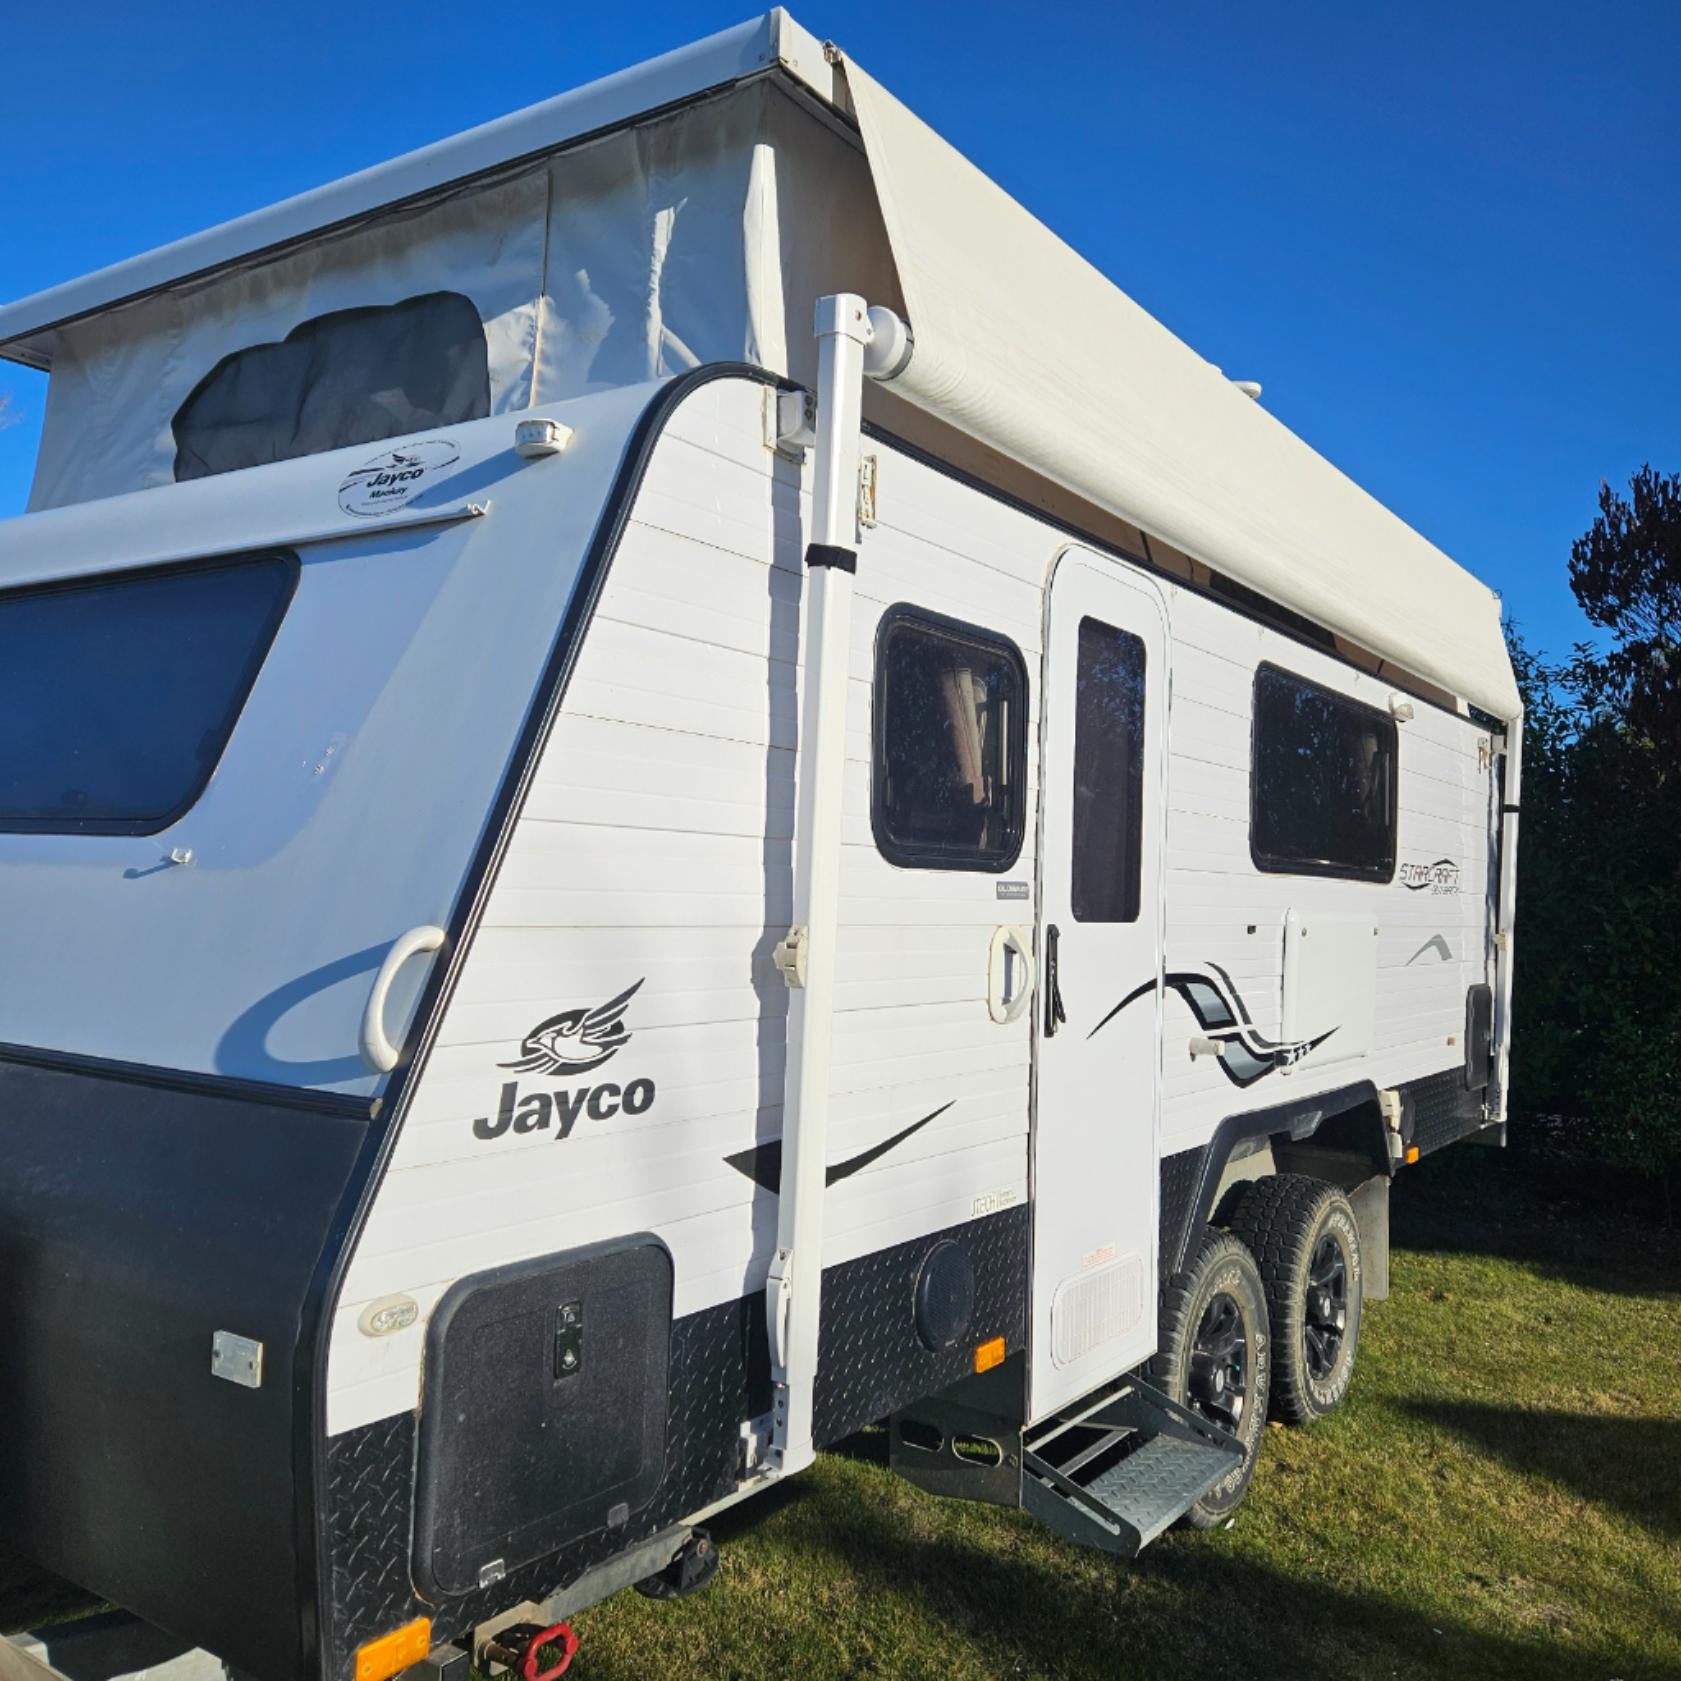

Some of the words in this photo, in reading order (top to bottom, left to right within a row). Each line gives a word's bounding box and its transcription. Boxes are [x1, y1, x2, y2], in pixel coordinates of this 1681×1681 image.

[366, 468, 424, 488] Jayco
[1399, 862, 1461, 885] STARCRAFT
[473, 1077, 655, 1140] Jayco
